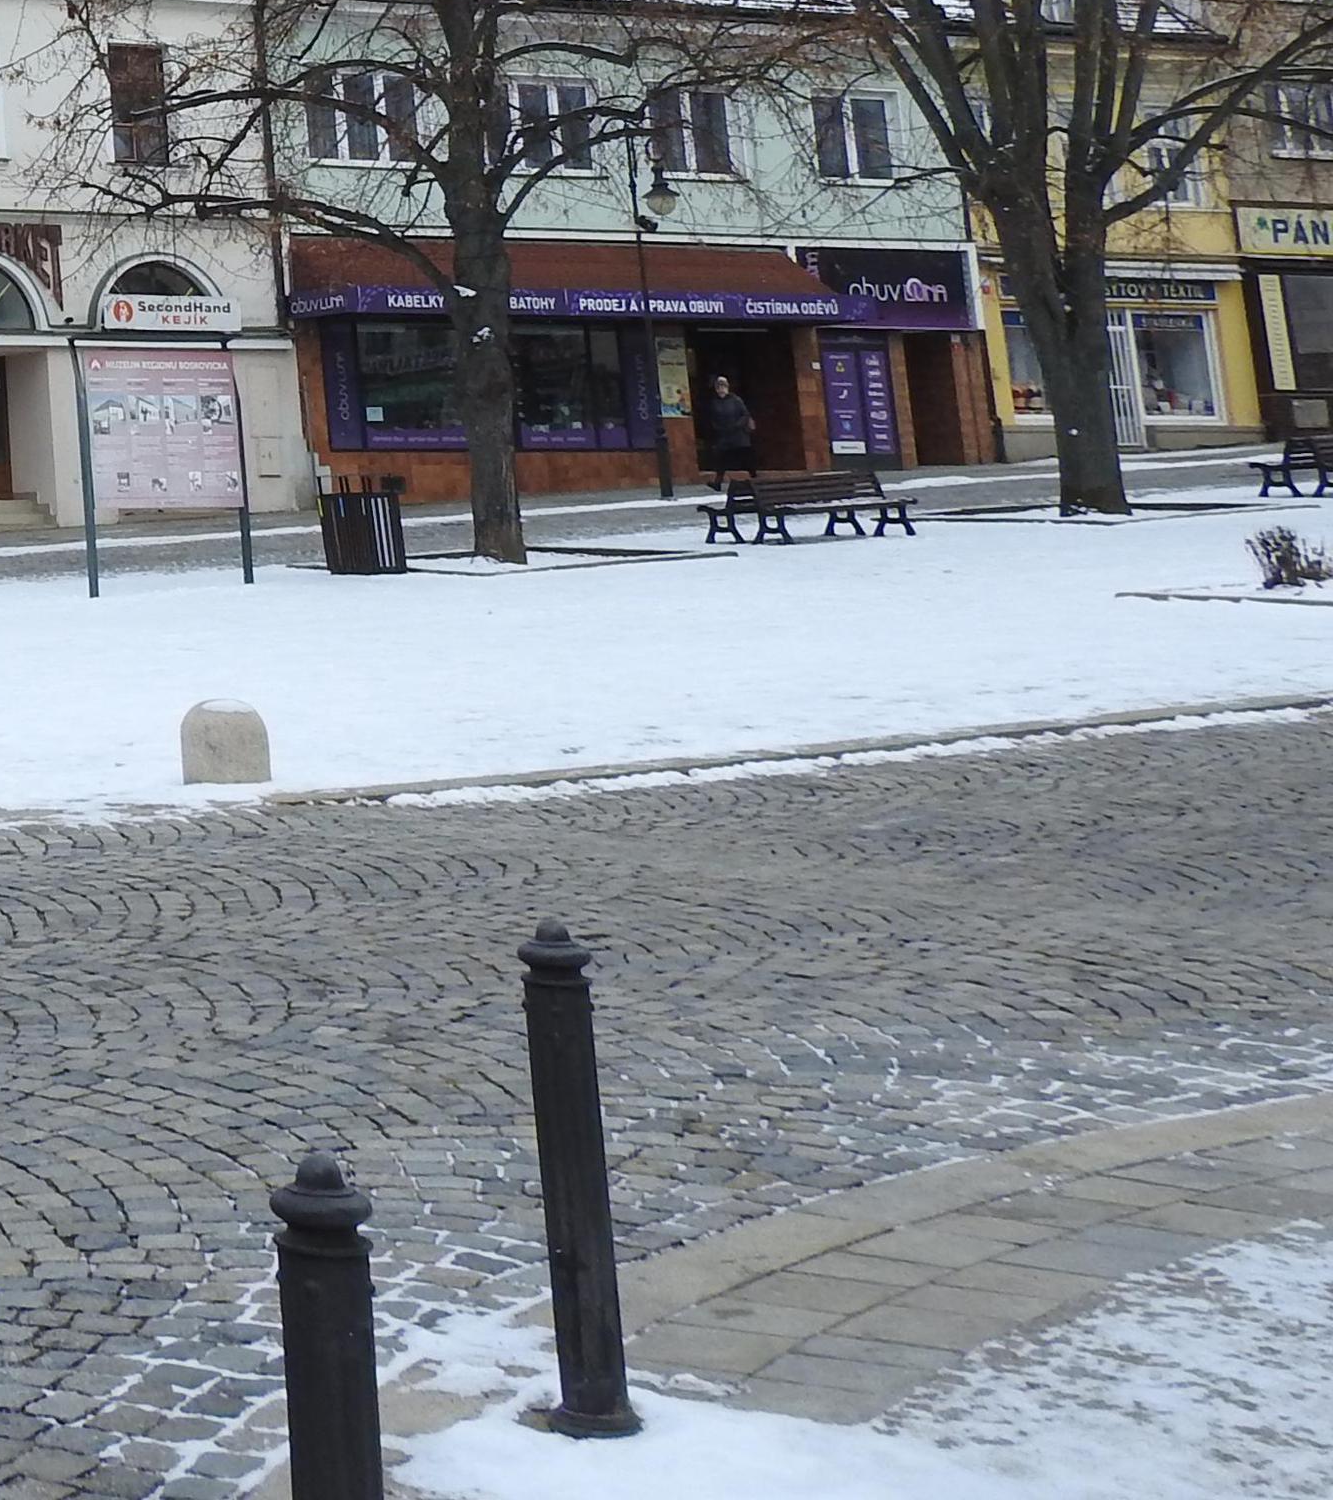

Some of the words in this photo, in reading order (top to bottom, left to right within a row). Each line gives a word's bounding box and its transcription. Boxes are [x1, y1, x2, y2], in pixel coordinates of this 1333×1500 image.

[137, 301, 231, 314] SecondHand
[387, 294, 445, 309] KABELKY
[509, 296, 556, 310] BATOHY
[579, 298, 627, 313] PRODEJ
[629, 299, 638, 312] A
[689, 299, 725, 315] OBUVI
[745, 296, 800, 315] ČISTÍRNA
[801, 297, 840, 315] ODĚVŮ
[161, 314, 209, 325] KEJÍK
